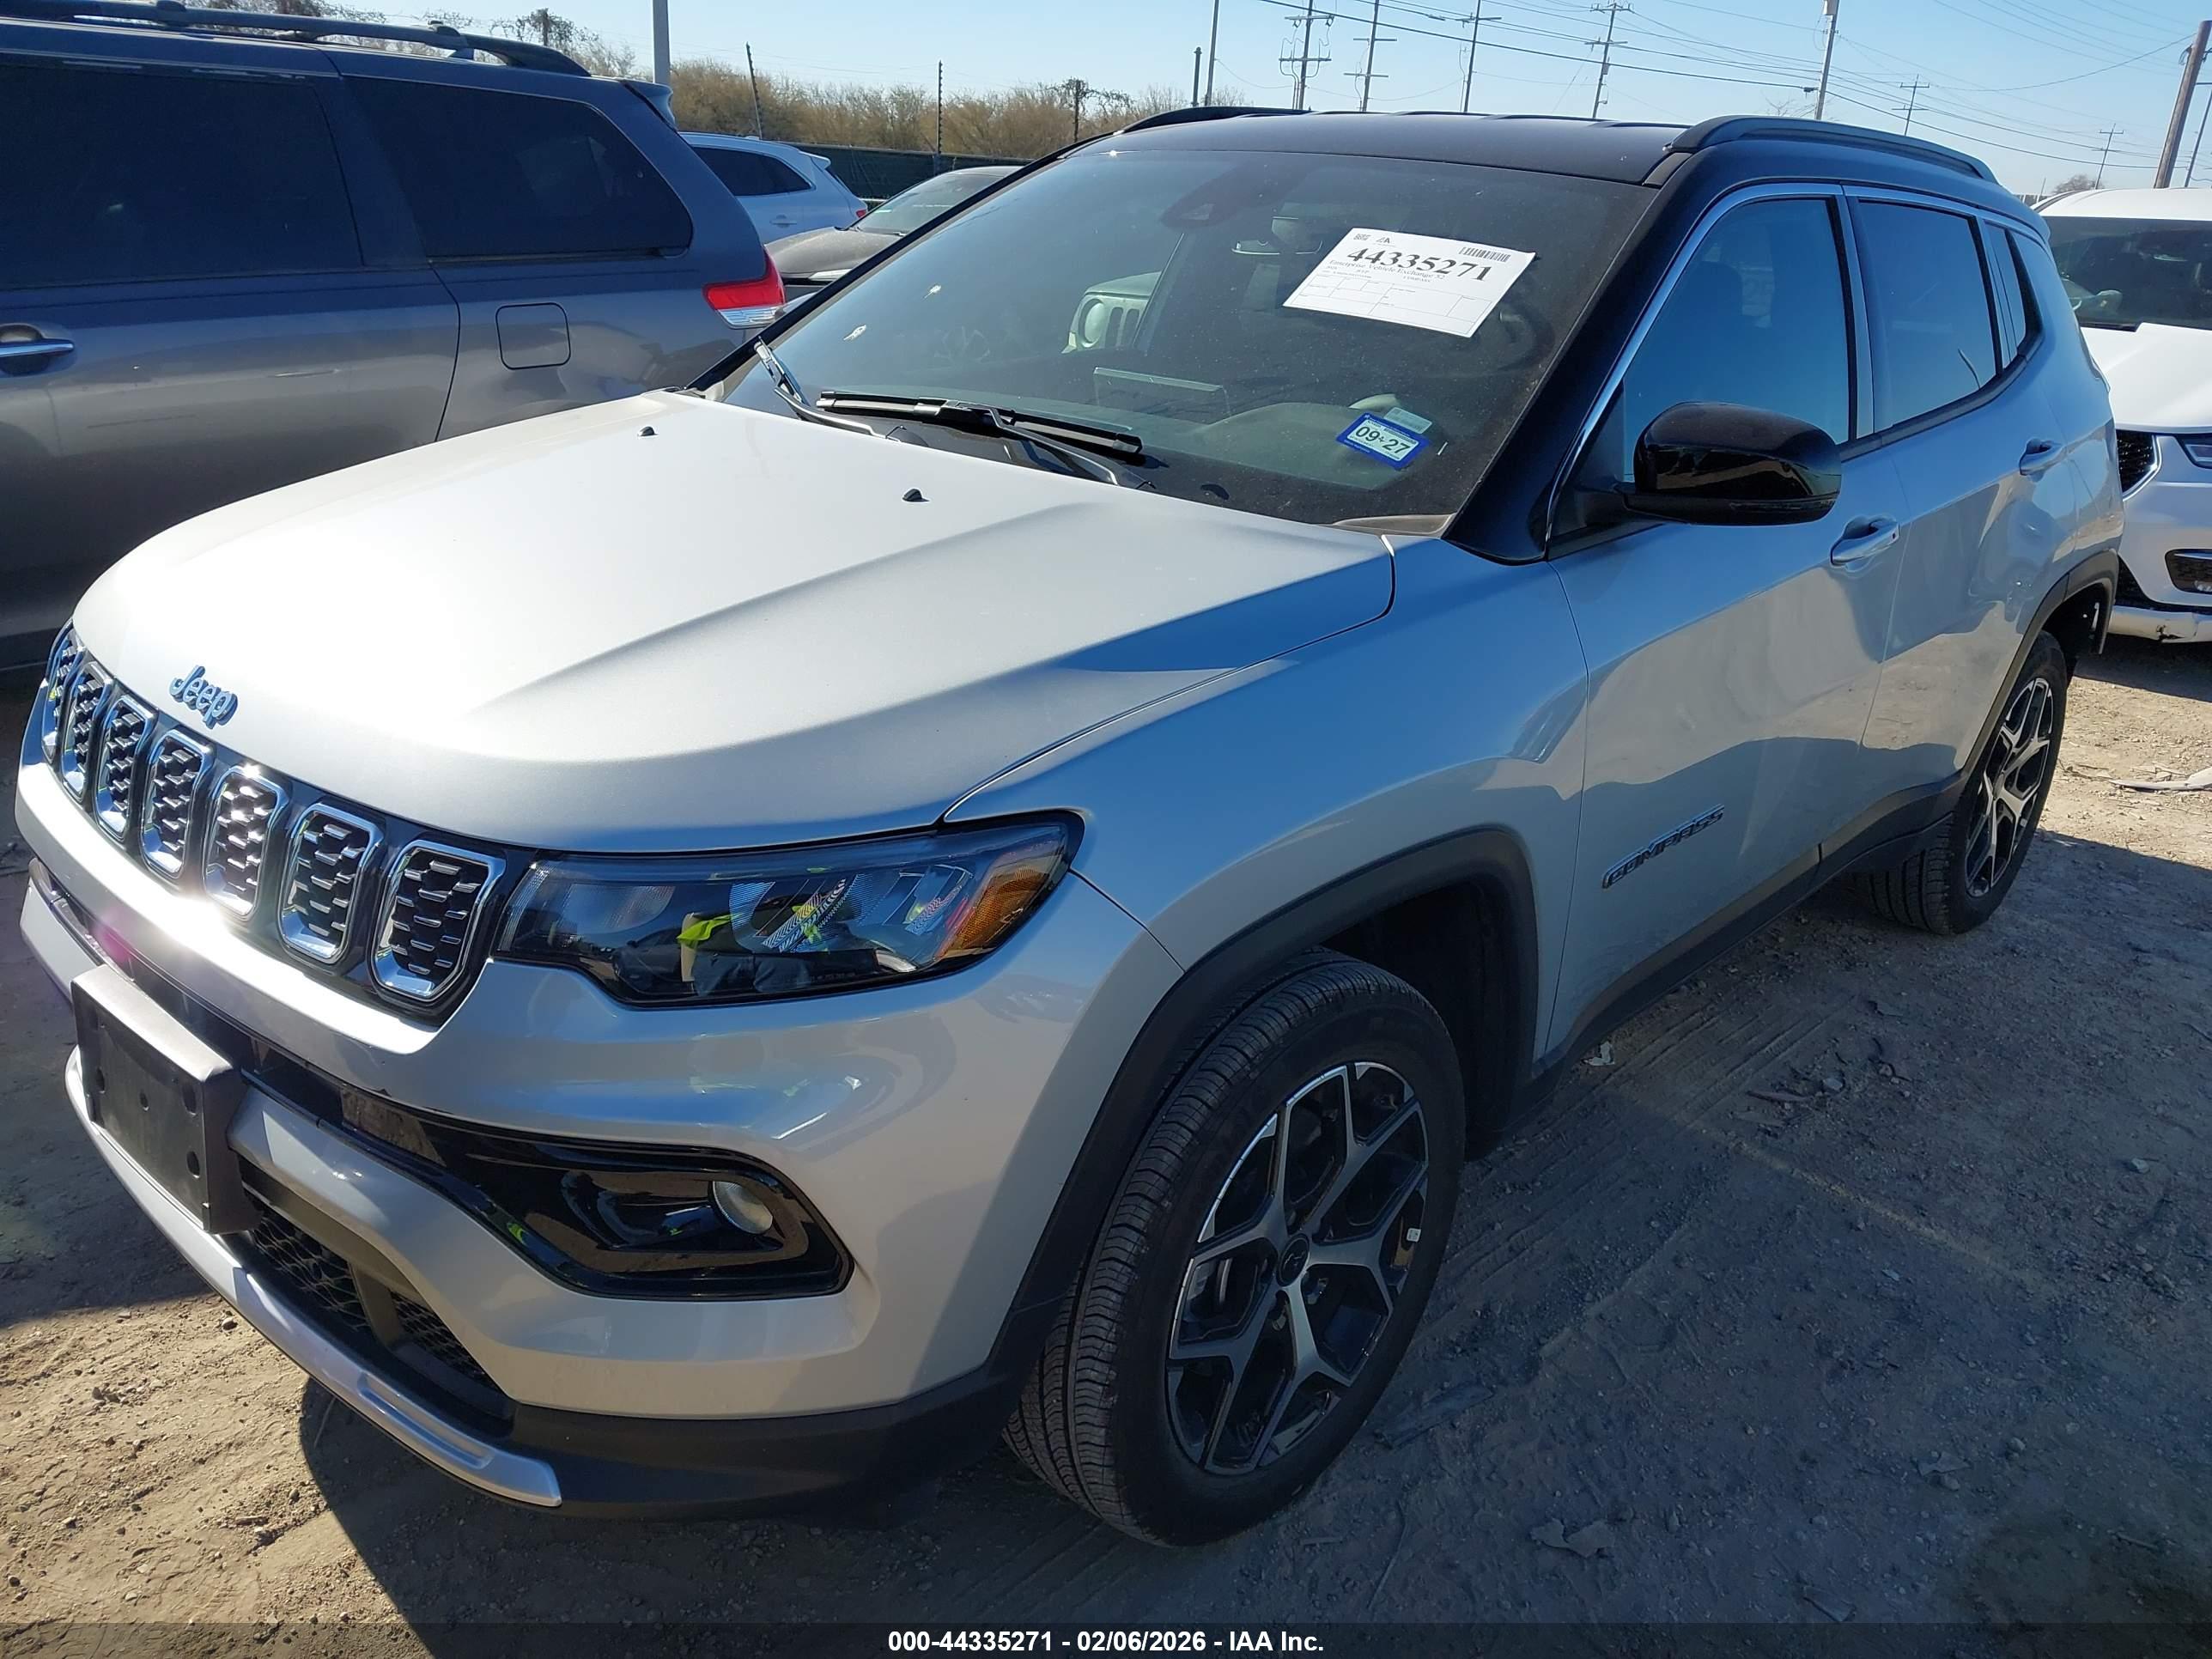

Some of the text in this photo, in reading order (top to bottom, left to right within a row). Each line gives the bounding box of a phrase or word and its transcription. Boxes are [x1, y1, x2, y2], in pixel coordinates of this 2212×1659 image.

[1346, 247, 1492, 282] 44335271
[1369, 263, 1395, 273] Vehicle
[1397, 268, 1434, 279] Exchange
[1355, 426, 1379, 442] 09
[1382, 439, 1411, 454] 27
[169, 665, 239, 729] Jeep
[1601, 804, 1725, 890] COMPASS
